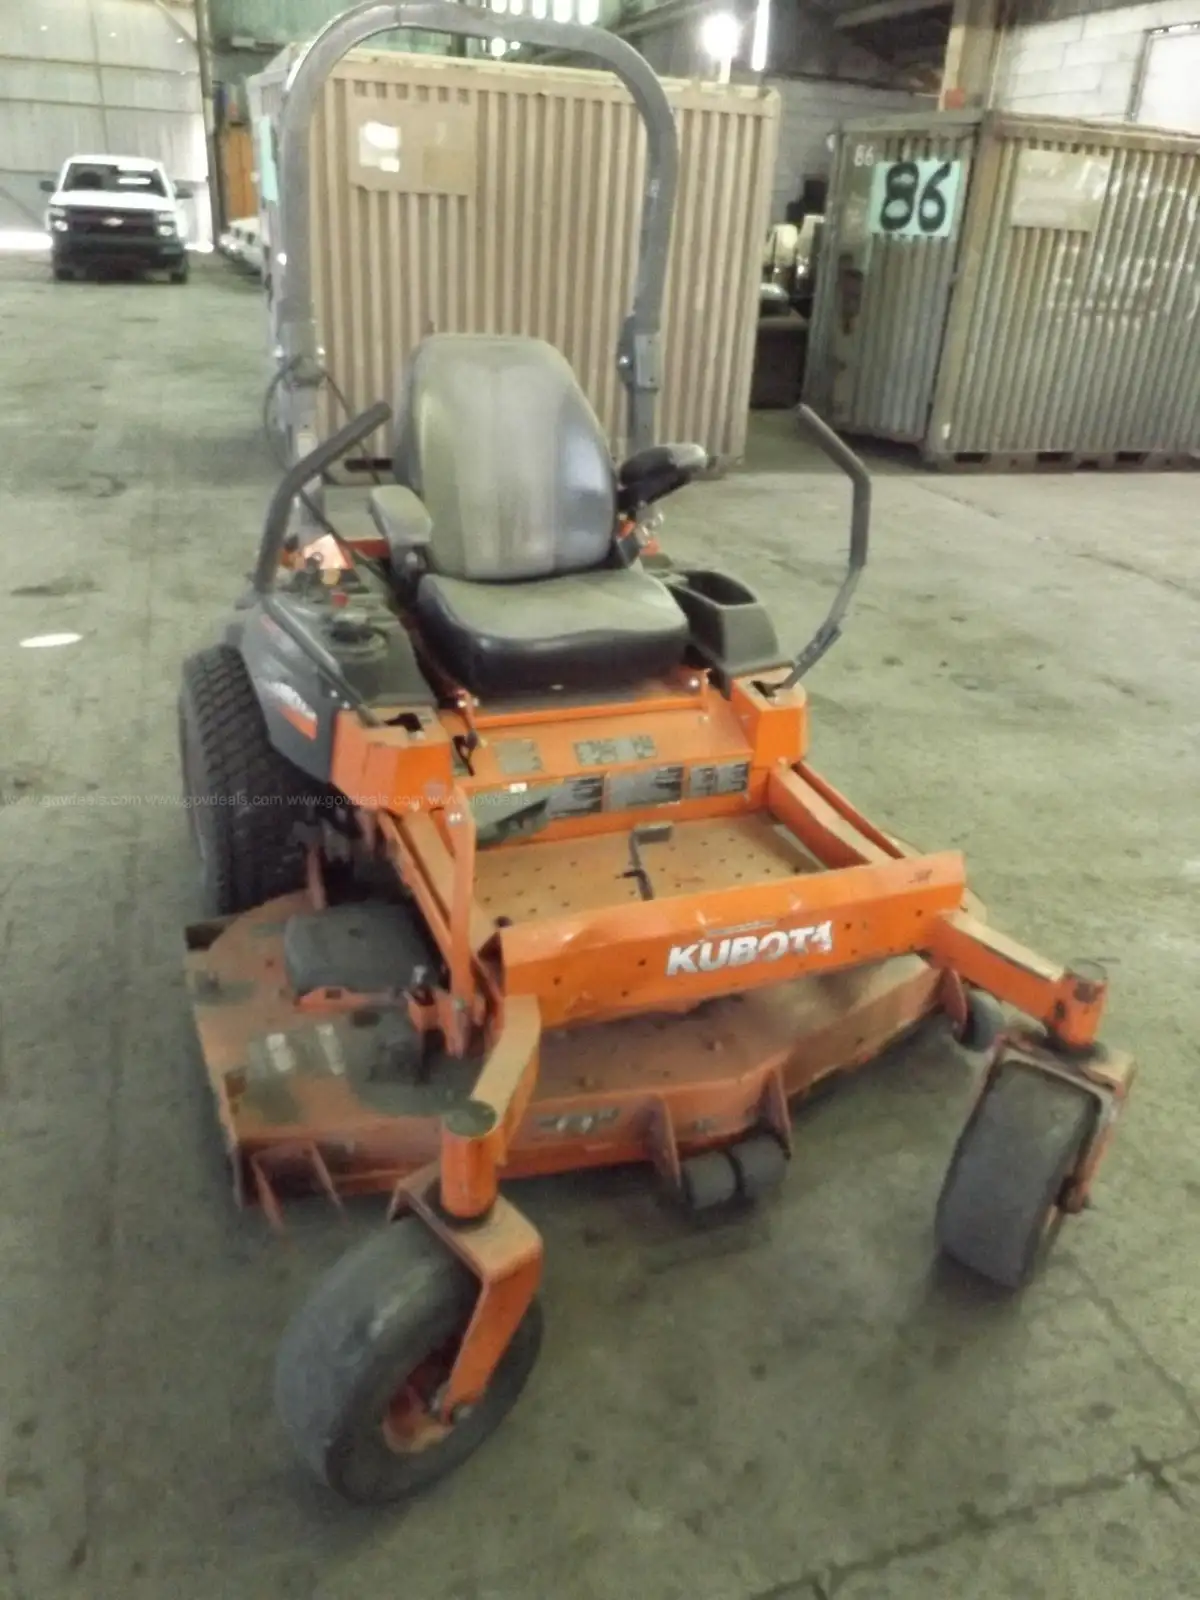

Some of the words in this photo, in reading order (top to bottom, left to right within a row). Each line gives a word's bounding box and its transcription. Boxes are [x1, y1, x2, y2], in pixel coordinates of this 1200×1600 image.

[854, 144, 874, 167] 86
[880, 161, 952, 232] 86
[665, 920, 832, 976] KUBOTA
